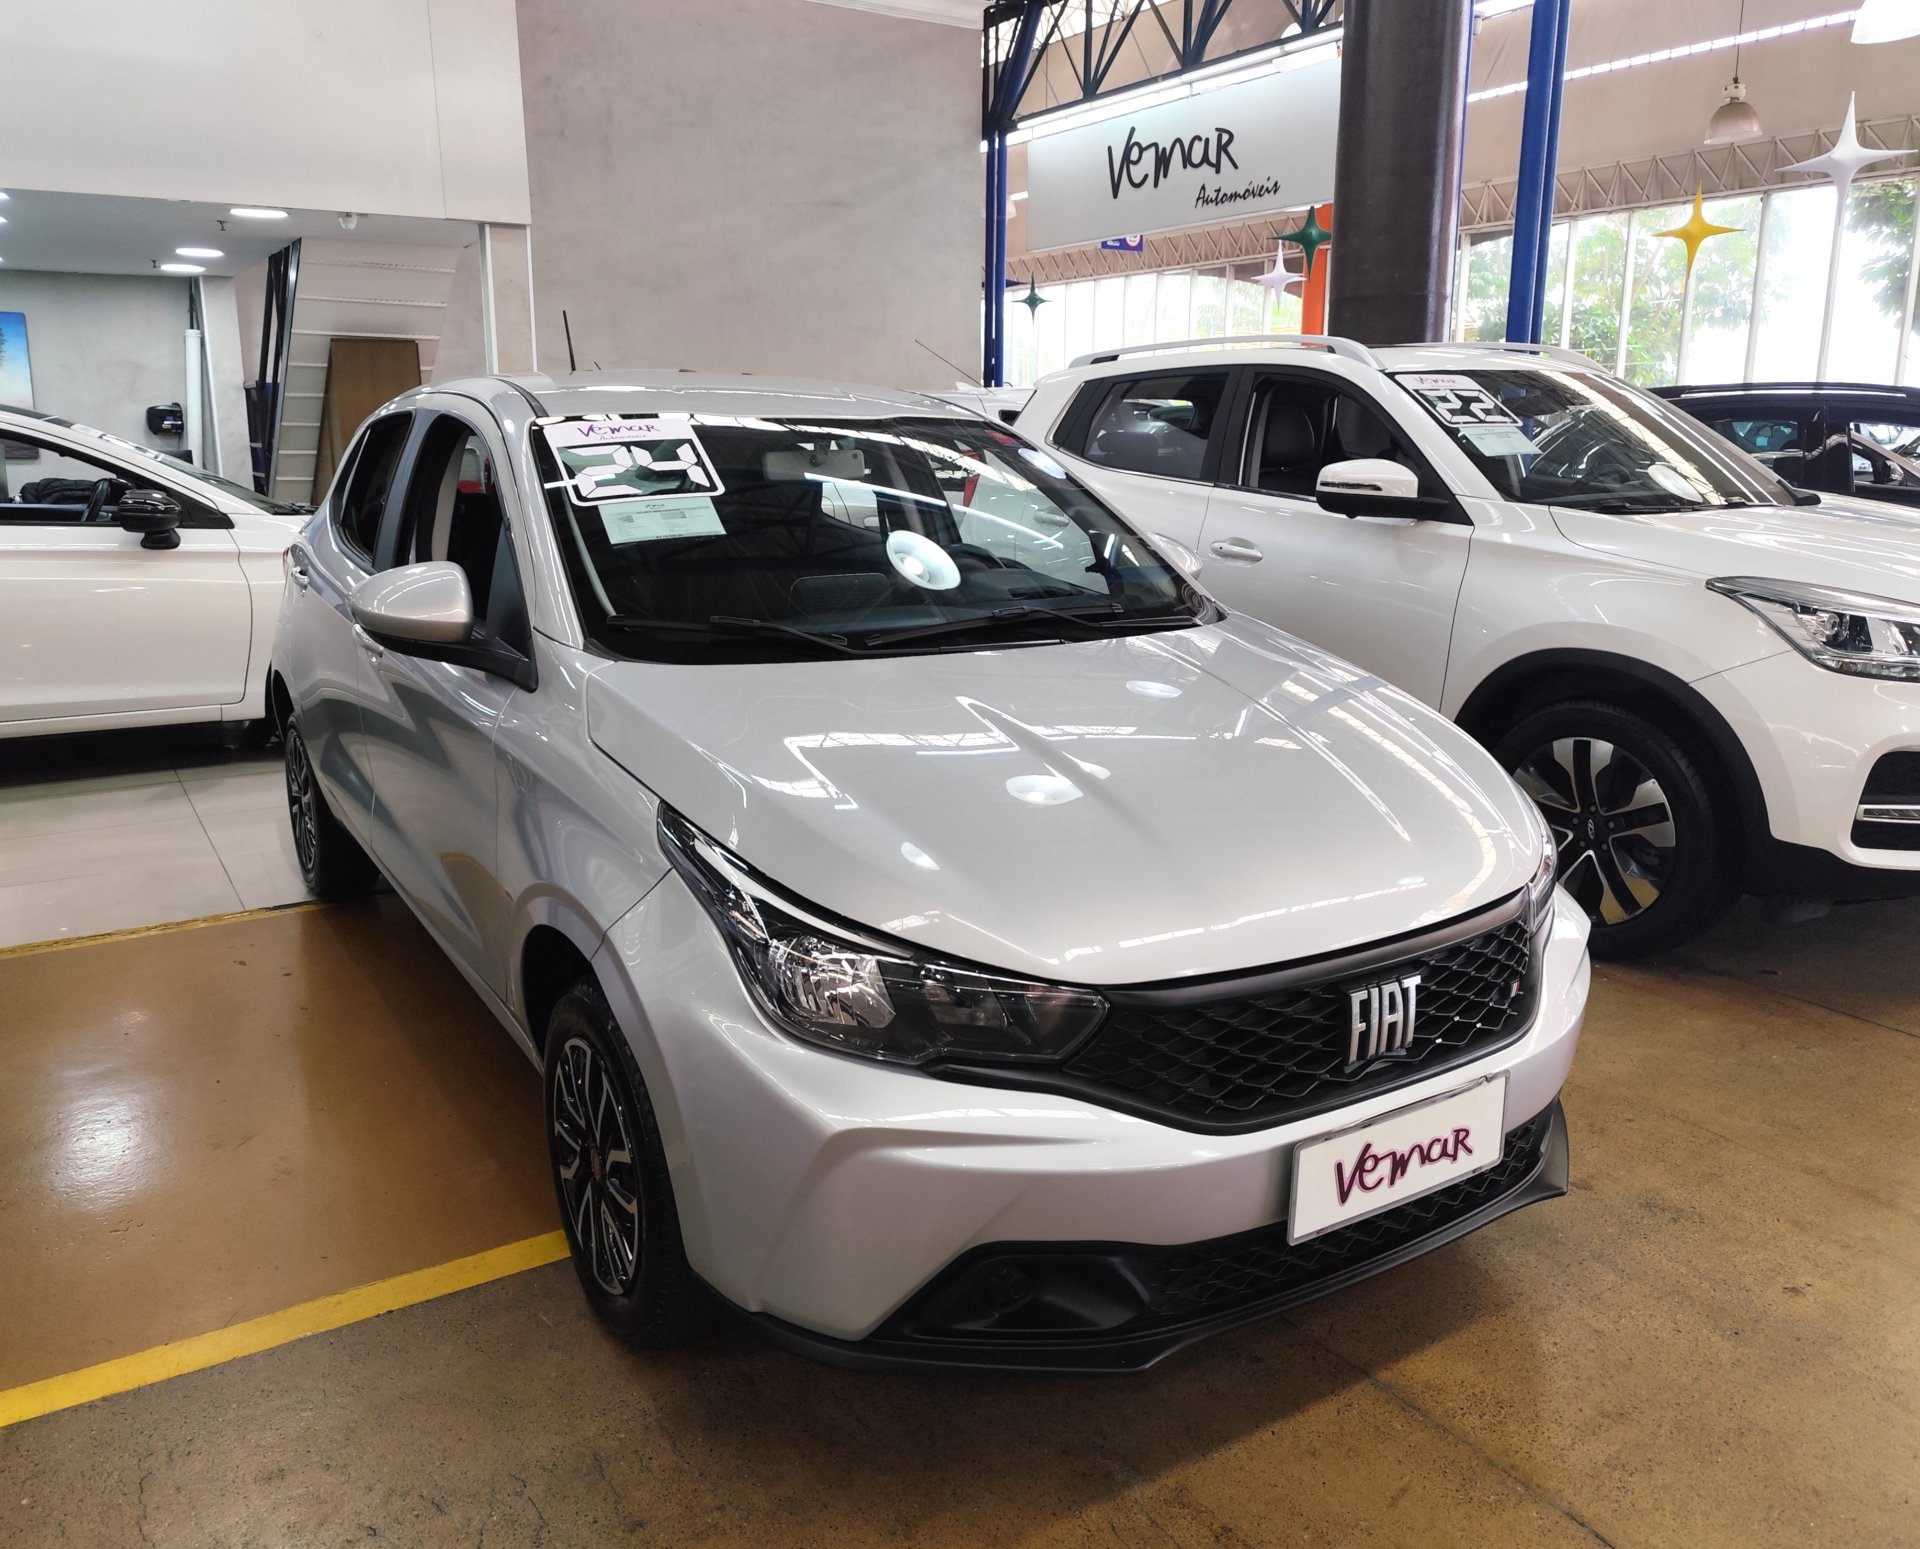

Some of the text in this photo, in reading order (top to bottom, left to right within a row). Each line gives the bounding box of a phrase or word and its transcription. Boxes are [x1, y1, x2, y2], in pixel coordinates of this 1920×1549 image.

[1194, 176, 1281, 209] Automóveis
[1418, 389, 1514, 423] 22
[565, 442, 711, 499] 24
[1348, 974, 1422, 1066] FIAT
